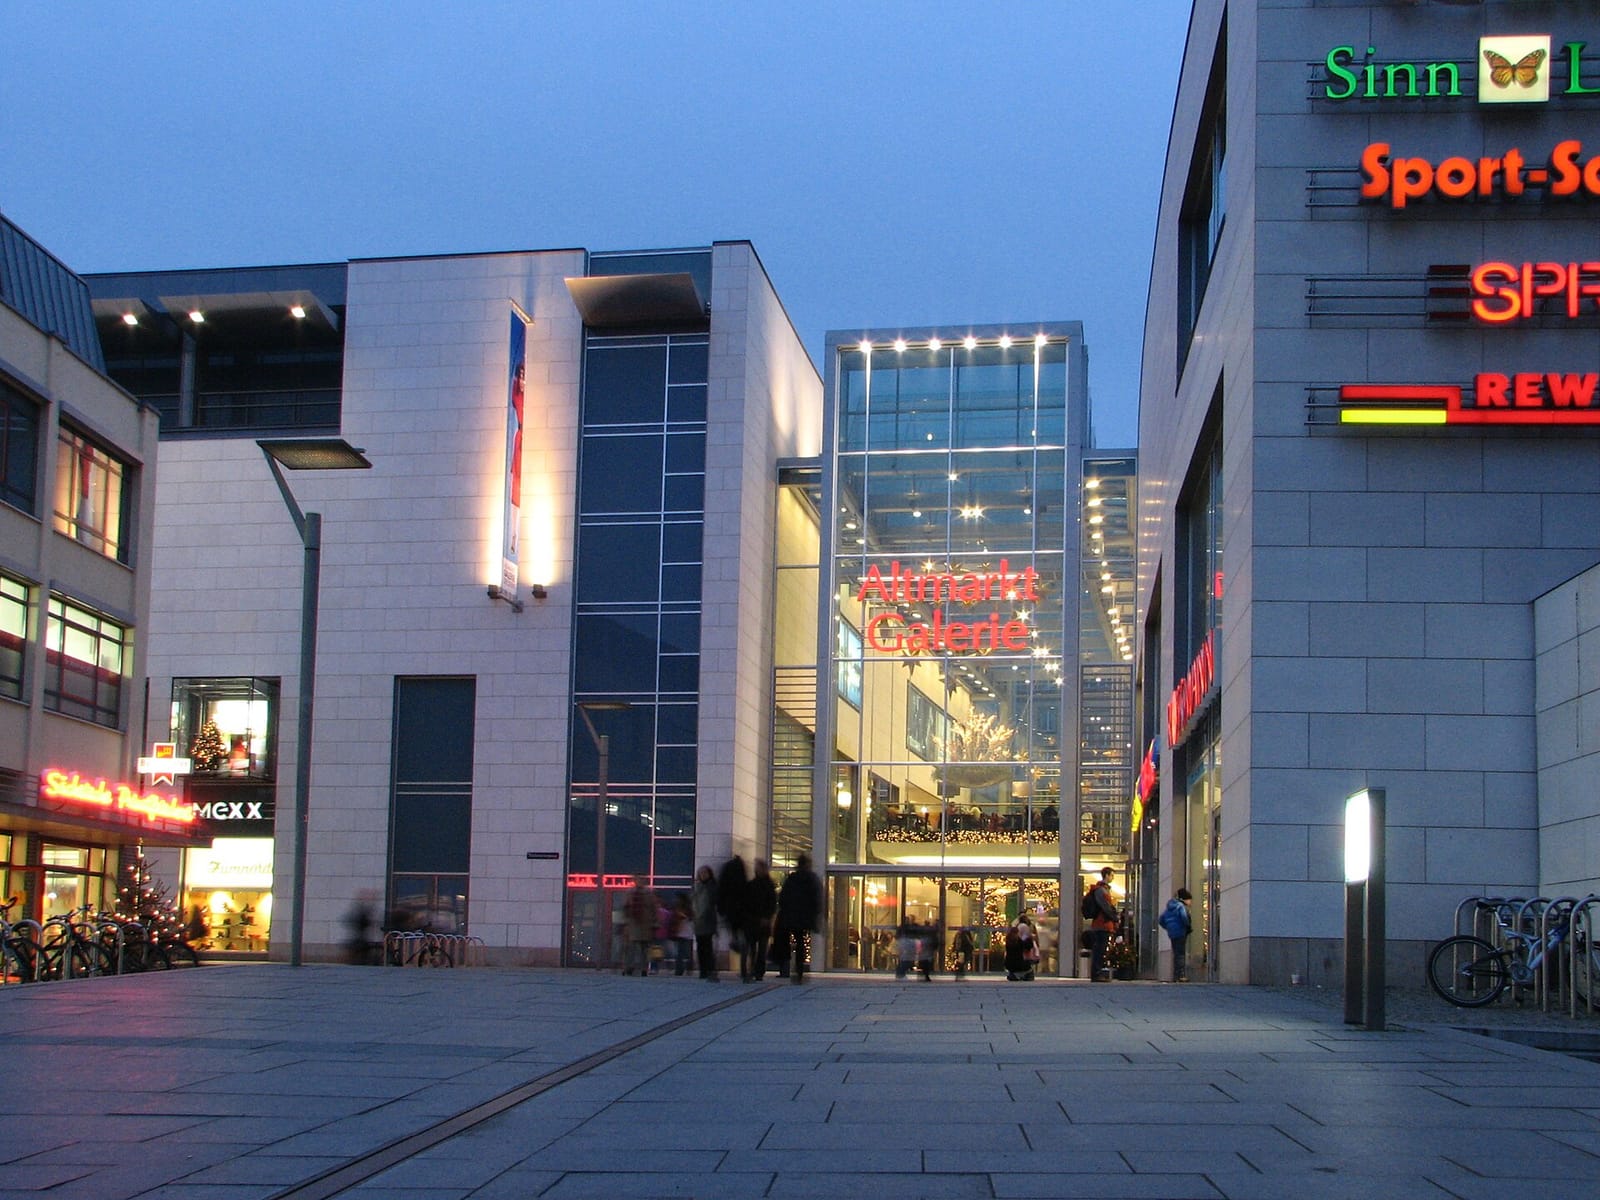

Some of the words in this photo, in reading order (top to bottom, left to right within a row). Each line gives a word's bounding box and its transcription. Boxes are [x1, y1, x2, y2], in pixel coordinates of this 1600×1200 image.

[1325, 46, 1463, 99] Sinn
[1476, 373, 1599, 407] REW
[857, 558, 1040, 602] Altmarkt
[867, 608, 1030, 652] Galerie
